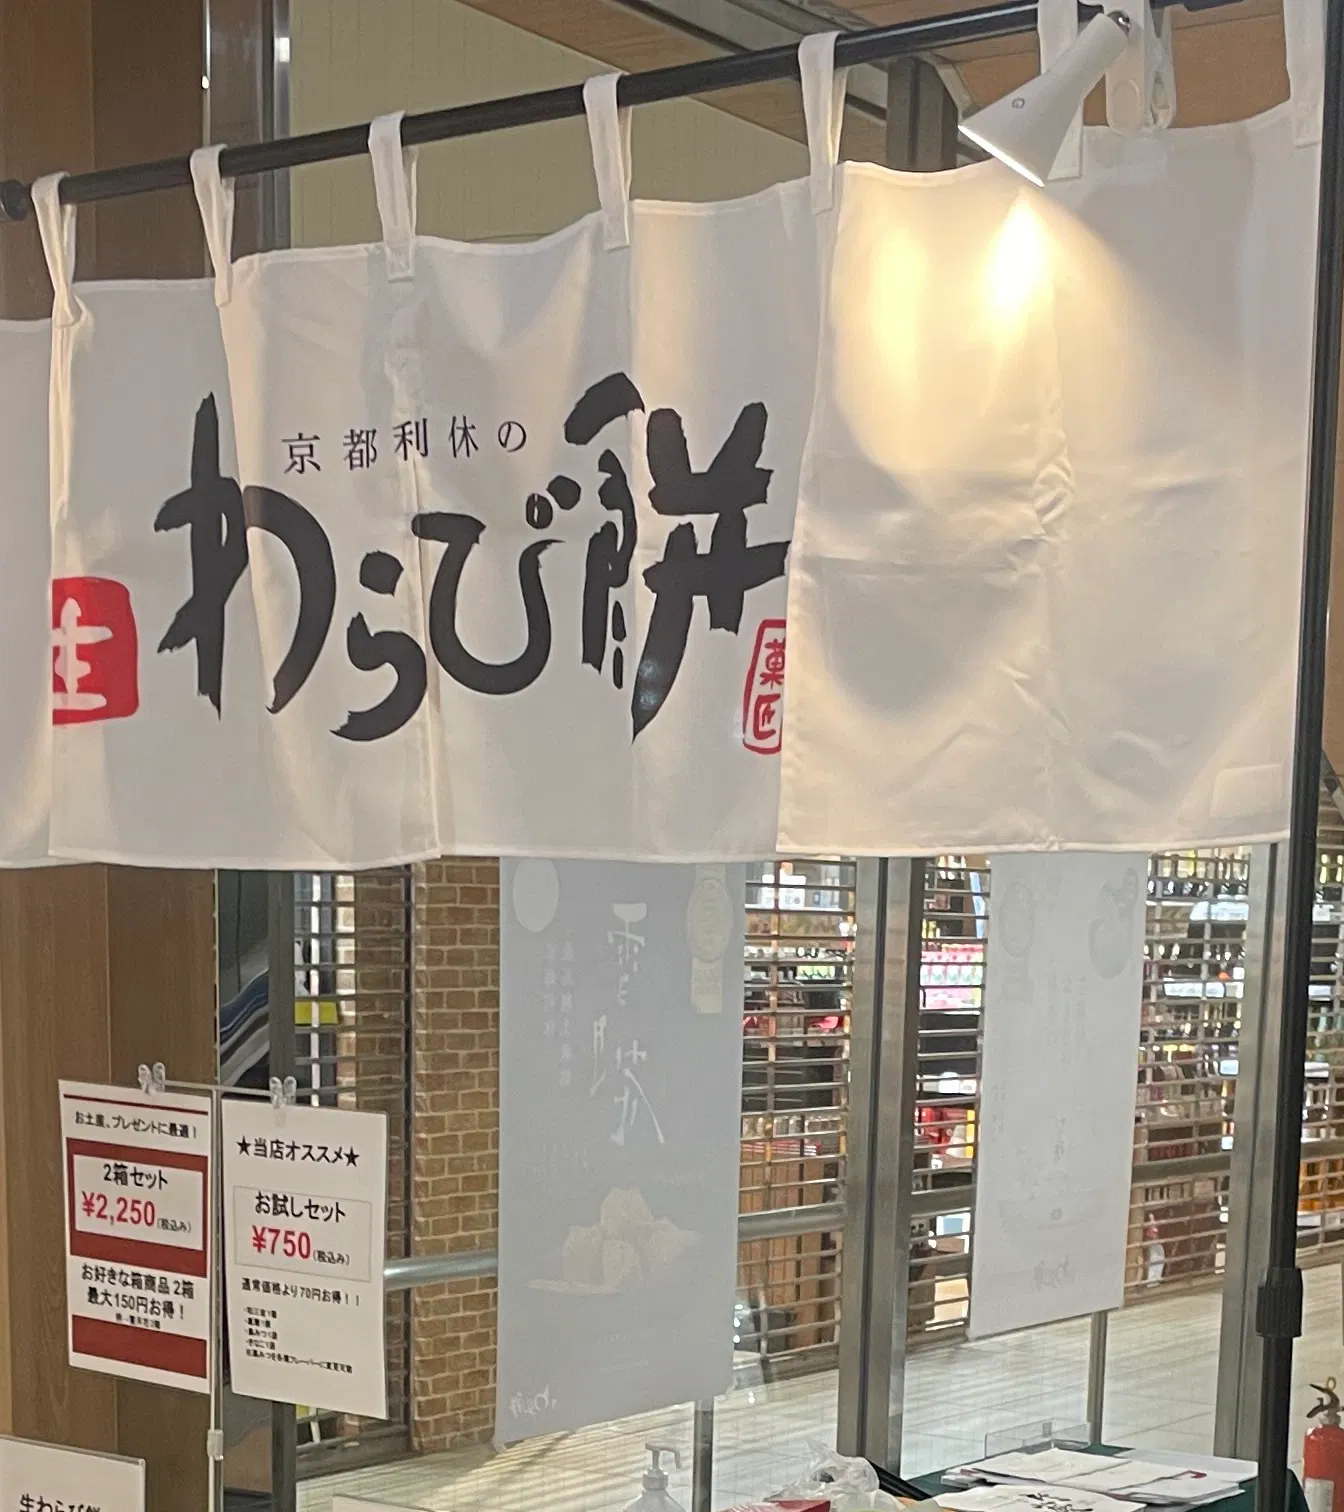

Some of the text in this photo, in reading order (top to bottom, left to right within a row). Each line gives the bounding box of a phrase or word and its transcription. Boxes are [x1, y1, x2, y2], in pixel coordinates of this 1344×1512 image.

[280, 414, 528, 476] 京都利休の
[153, 371, 792, 744] わらび餅
[102, 1163, 169, 1190] 2箱セット
[81, 1190, 155, 1227] ¥2,250
[254, 1190, 346, 1223] お試しセット
[252, 1224, 312, 1260] ¥750
